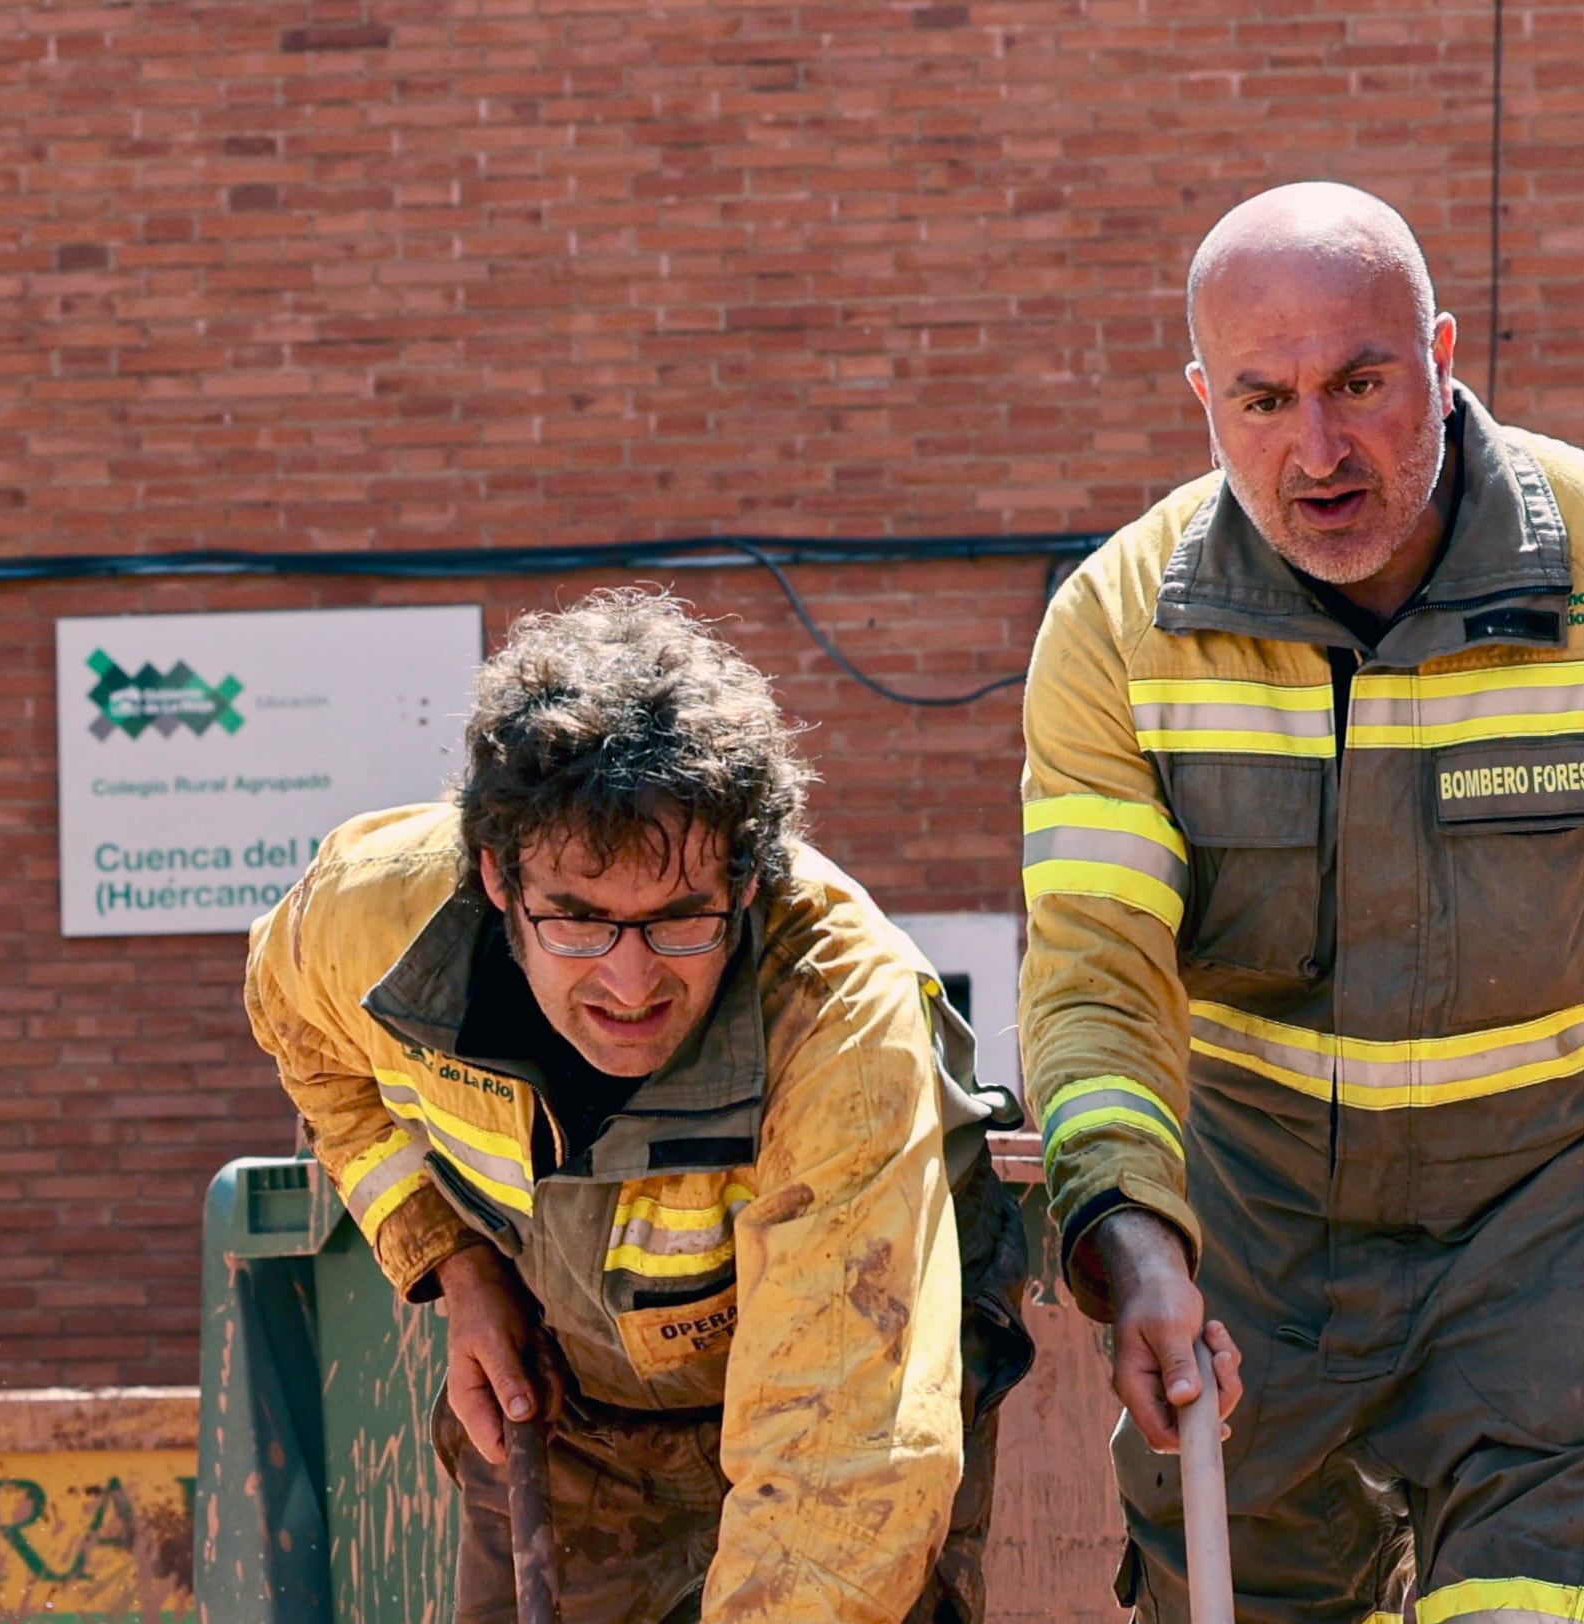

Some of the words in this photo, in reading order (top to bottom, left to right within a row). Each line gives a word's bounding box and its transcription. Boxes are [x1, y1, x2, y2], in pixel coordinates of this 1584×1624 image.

[92, 777, 169, 798] Colegio
[174, 775, 227, 794] Rural
[233, 772, 332, 796] Agrupado
[1440, 765, 1529, 800] BOMBERO
[94, 842, 232, 873] Cuenca
[243, 838, 297, 869] del
[94, 876, 292, 918] (Huércano
[439, 1063, 461, 1083] de
[482, 1077, 515, 1103] Rioj
